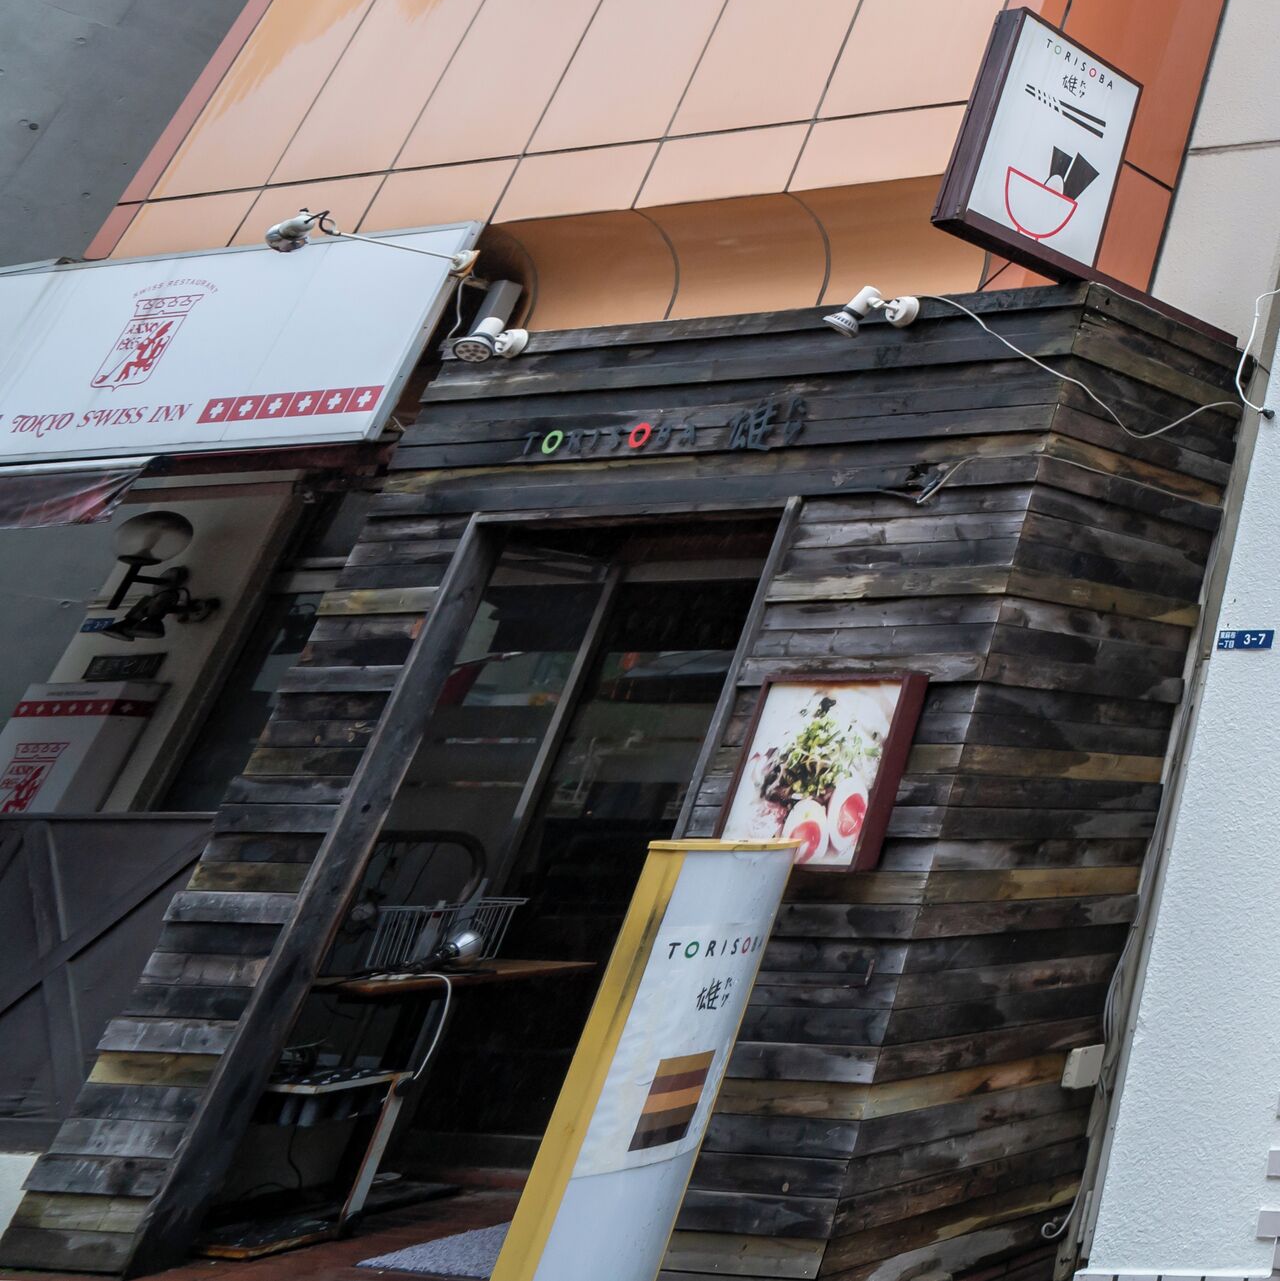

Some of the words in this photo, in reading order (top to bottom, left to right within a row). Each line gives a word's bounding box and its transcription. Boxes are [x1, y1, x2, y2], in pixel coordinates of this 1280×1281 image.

[1045, 38, 1114, 90] TORISOBA
[1062, 74, 1079, 97] 雄
[166, 278, 219, 295] RESTAURANT
[9, 412, 75, 438] TOKYO
[76, 406, 149, 429] SWISS
[147, 403, 193, 424] INN
[523, 421, 697, 457] TORISOBA
[1243, 633, 1266, 645] 3-7
[696, 978, 722, 1012] 雄
